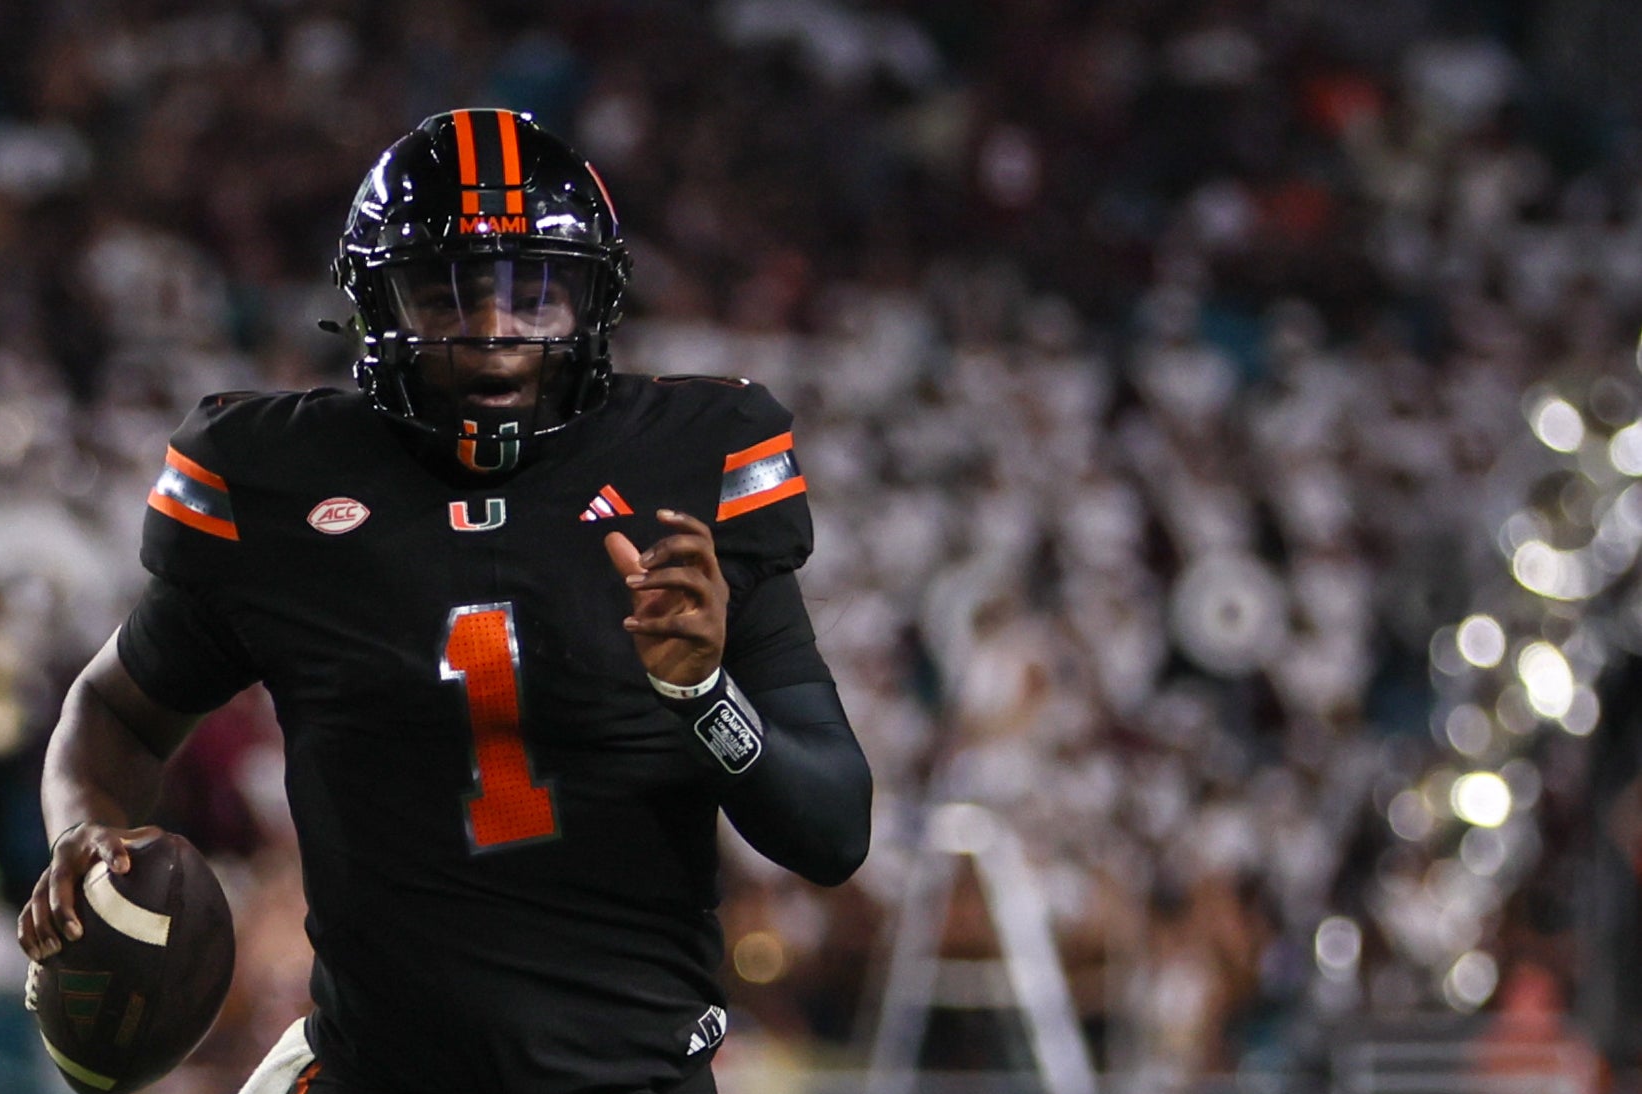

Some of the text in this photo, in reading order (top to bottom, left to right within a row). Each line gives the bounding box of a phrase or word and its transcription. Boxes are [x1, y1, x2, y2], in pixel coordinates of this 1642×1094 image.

[458, 419, 519, 472] U
[318, 506, 358, 521] ACC
[449, 498, 506, 531] U
[439, 602, 560, 855] 1
